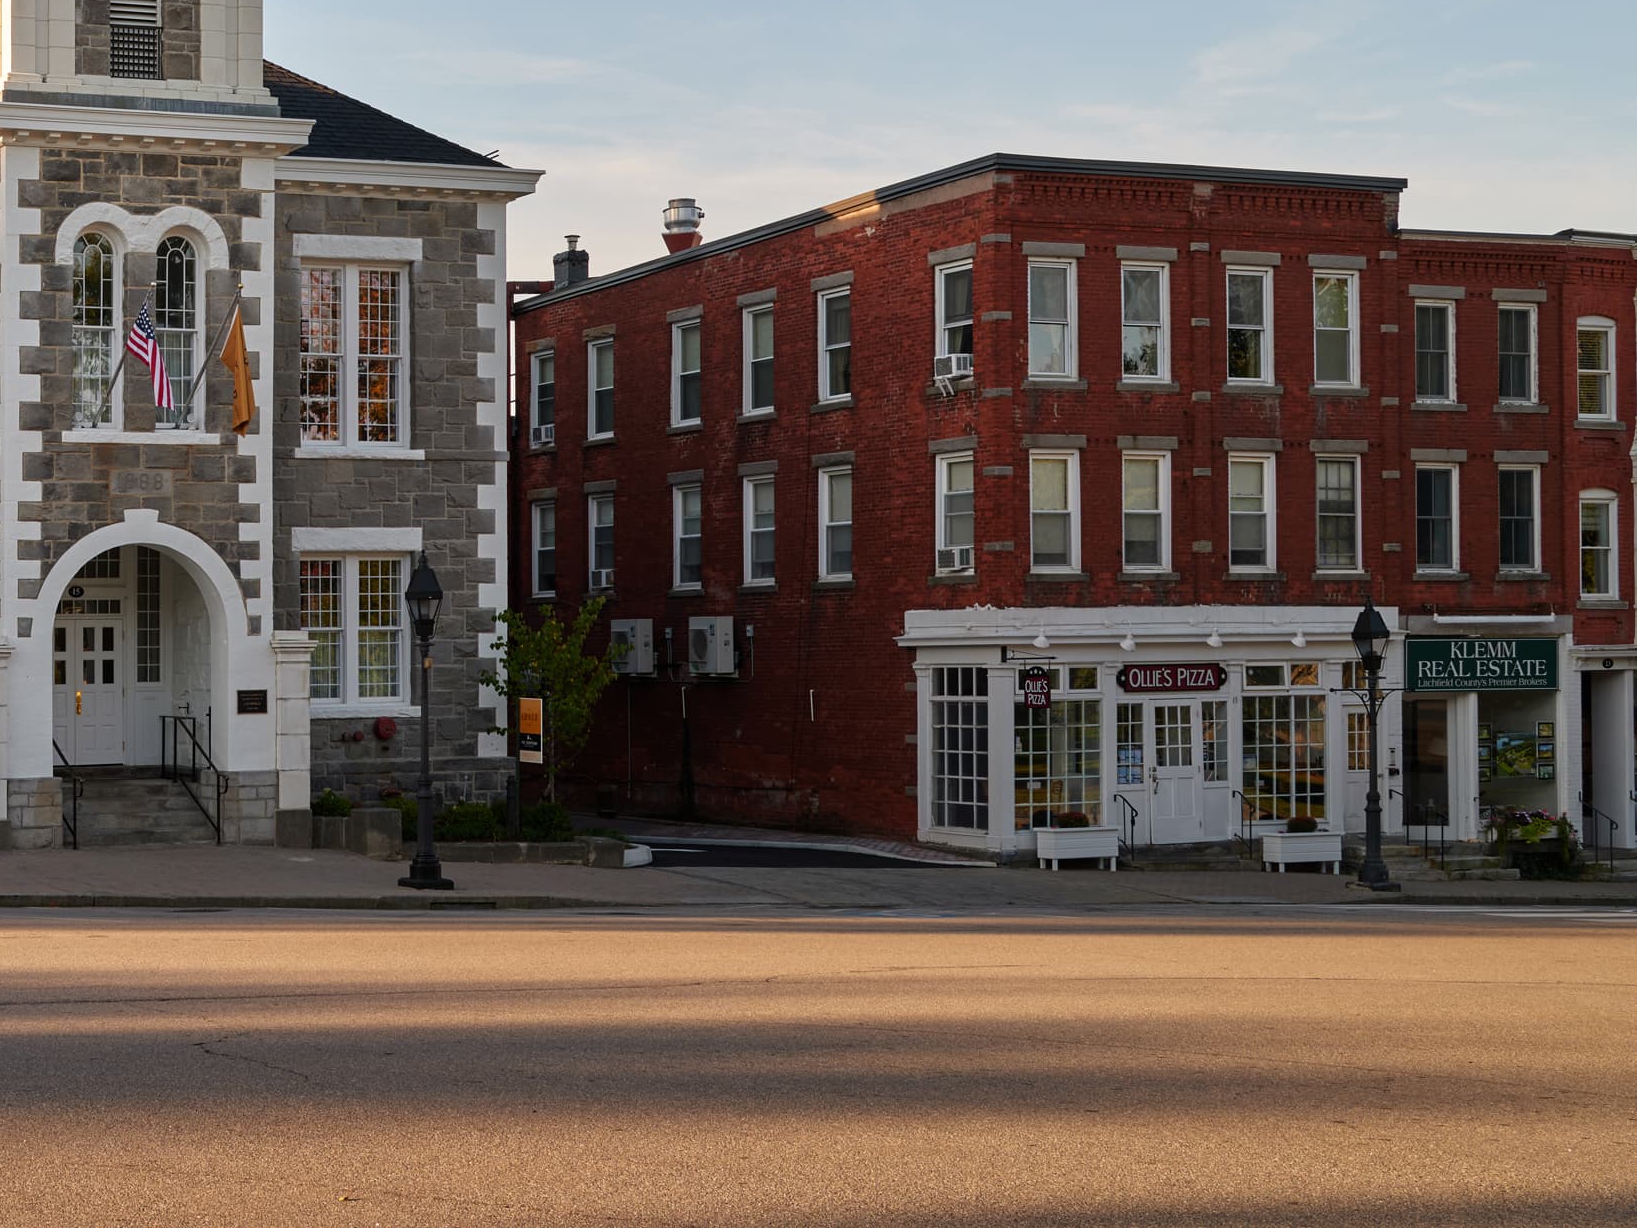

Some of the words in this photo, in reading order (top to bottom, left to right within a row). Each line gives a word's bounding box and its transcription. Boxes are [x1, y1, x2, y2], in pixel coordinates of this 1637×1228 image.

[72, 587, 81, 596] 15
[1450, 641, 1516, 658] KLEMM
[1418, 660, 1471, 677] REAL
[1476, 659, 1548, 676] ESTATE
[1129, 667, 1173, 688] OLLIE'S
[1177, 668, 1215, 687] PIZZA
[1418, 678, 1453, 687] Litchfield
[1454, 677, 1487, 688] County's
[1488, 677, 1517, 686] Premier
[1518, 677, 1547, 686] Brokers
[1025, 679, 1048, 693] OLLIE'S
[1027, 693, 1047, 705] PIZZA
